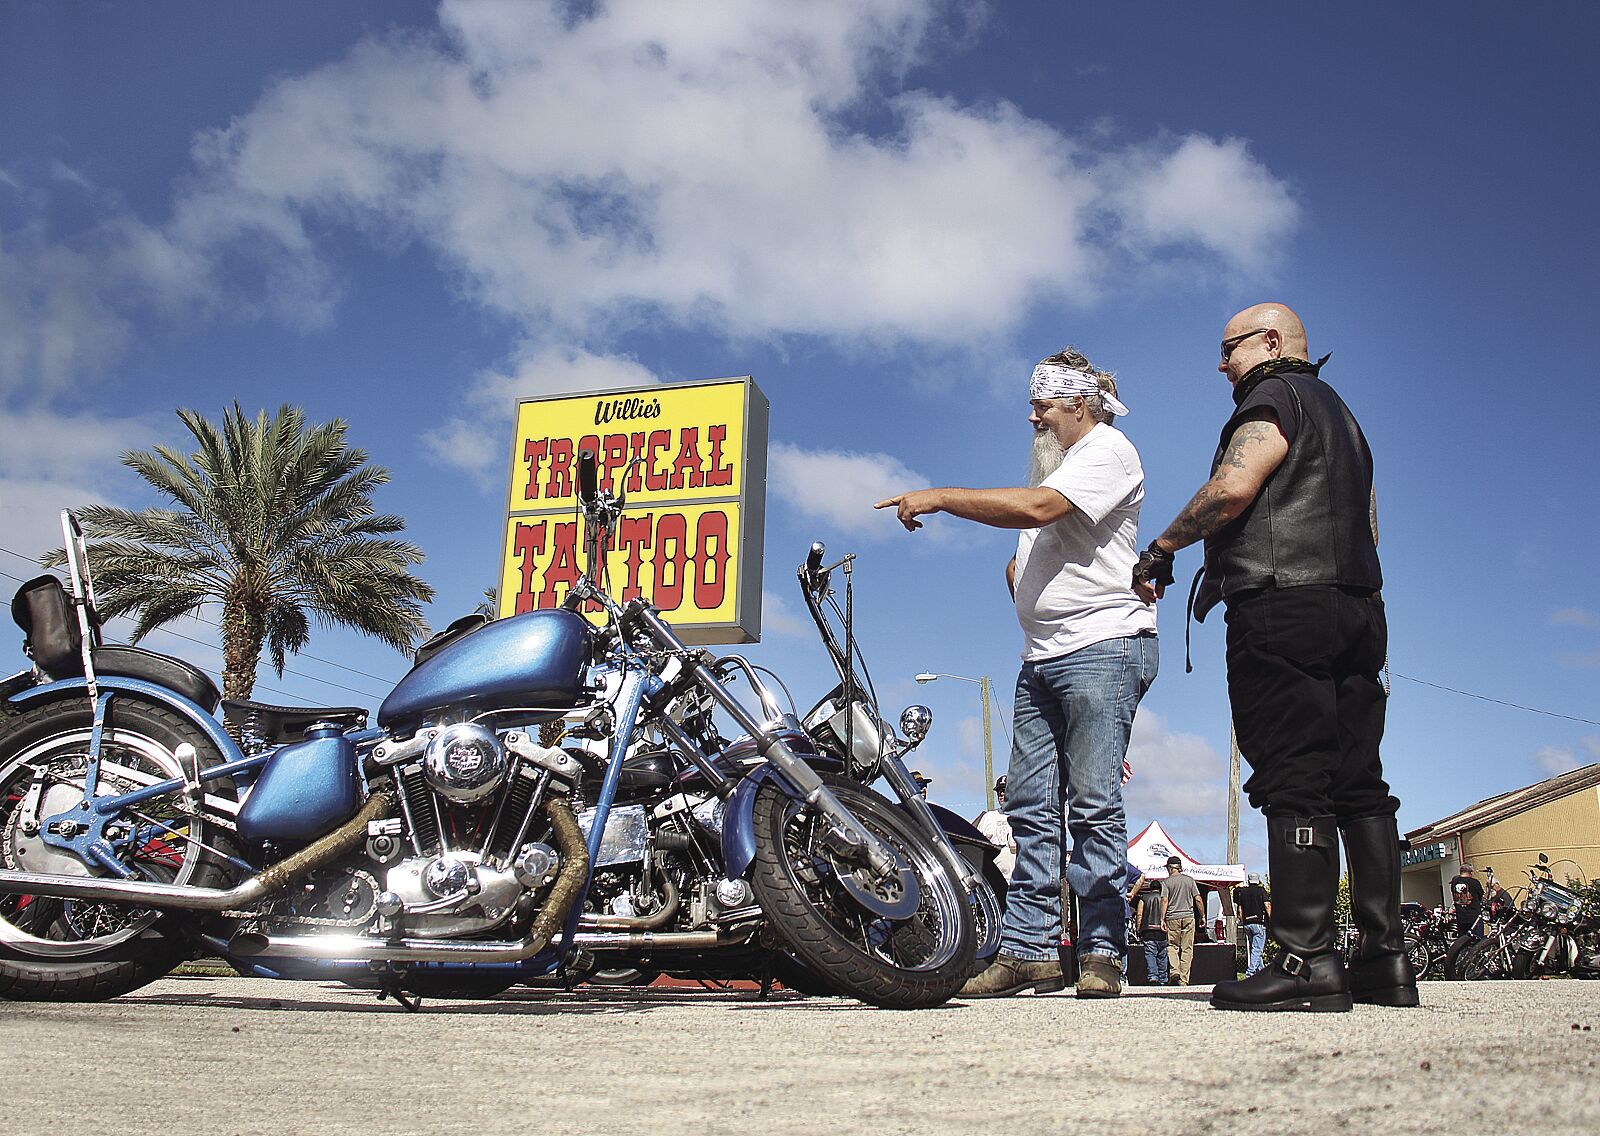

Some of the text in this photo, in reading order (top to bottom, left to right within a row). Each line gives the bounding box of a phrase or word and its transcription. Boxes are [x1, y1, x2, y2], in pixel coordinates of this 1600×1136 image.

[594, 398, 661, 426] Willie's
[523, 424, 733, 501] TROPICAL
[513, 510, 732, 616] TATTOO
[1400, 842, 1446, 866] RANCE
